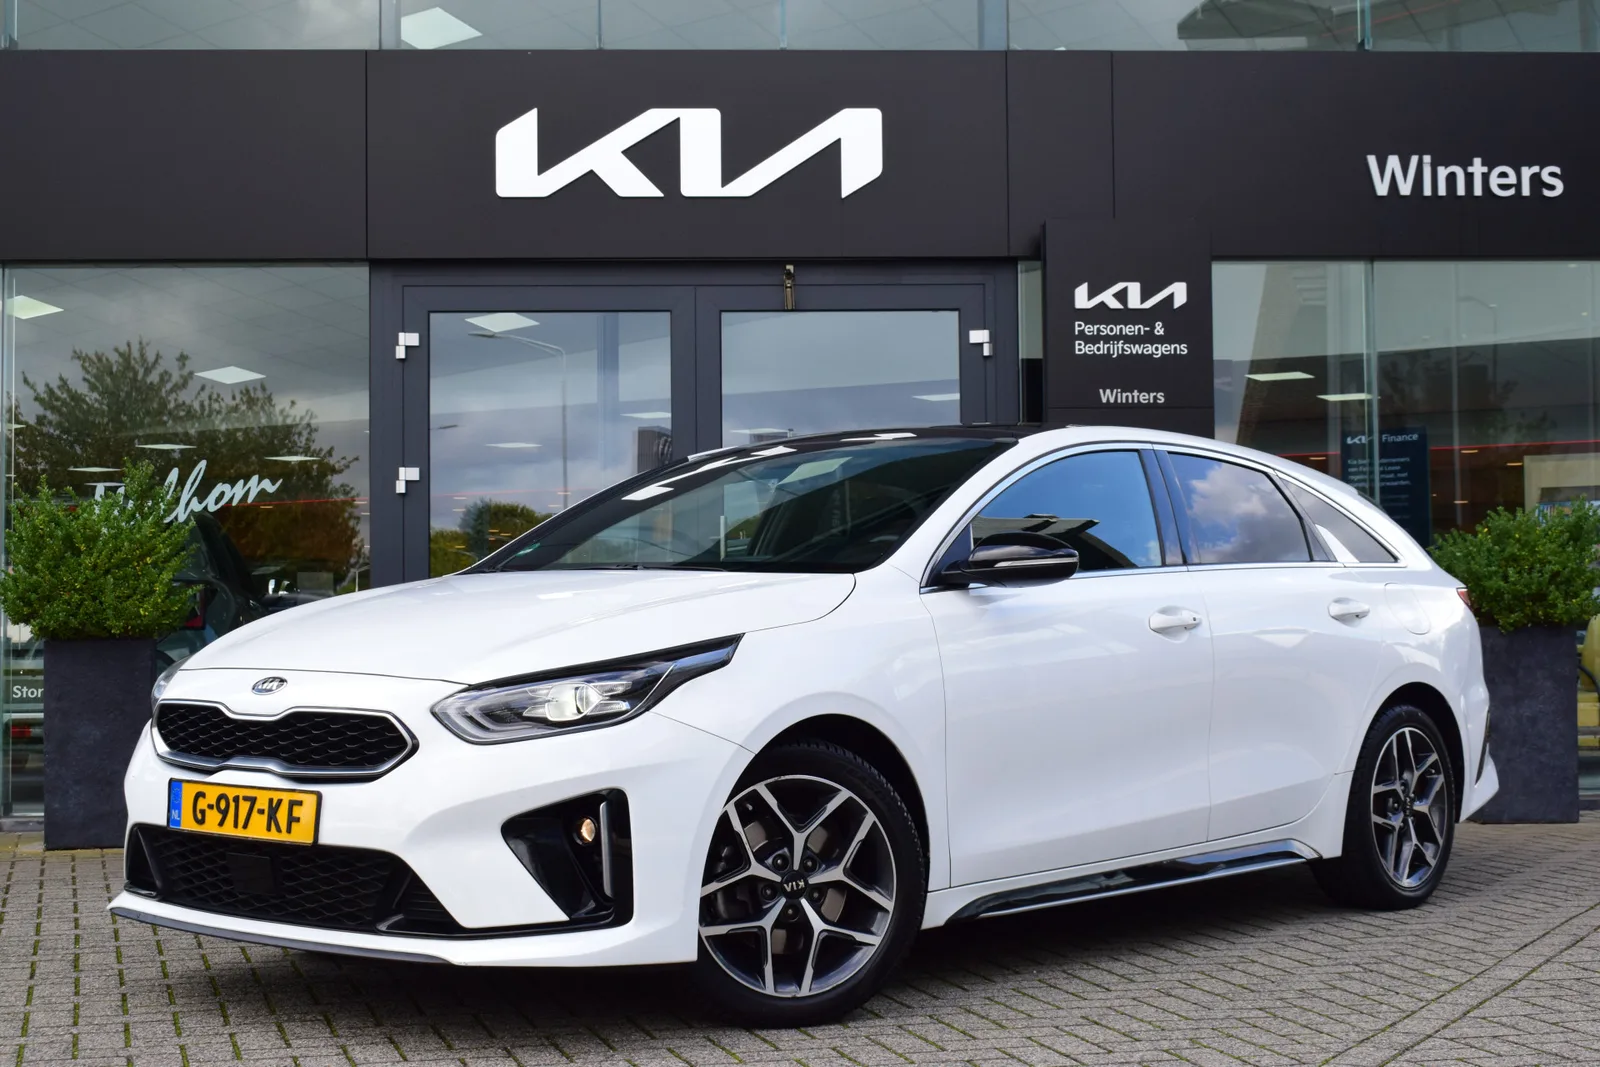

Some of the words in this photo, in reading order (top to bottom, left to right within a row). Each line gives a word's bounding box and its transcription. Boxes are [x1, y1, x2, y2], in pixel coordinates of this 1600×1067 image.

[496, 107, 883, 198] KIA
[1366, 155, 1564, 197] Winters
[1074, 282, 1187, 309] KIA
[1074, 321, 1150, 335] Personen-
[1154, 321, 1165, 335] &
[1074, 340, 1188, 358] Bedrijfswagens
[1099, 389, 1165, 403] Winters
[1382, 433, 1419, 442] Finance
[171, 809, 181, 820] NL
[192, 791, 303, 834] G-917-KF
